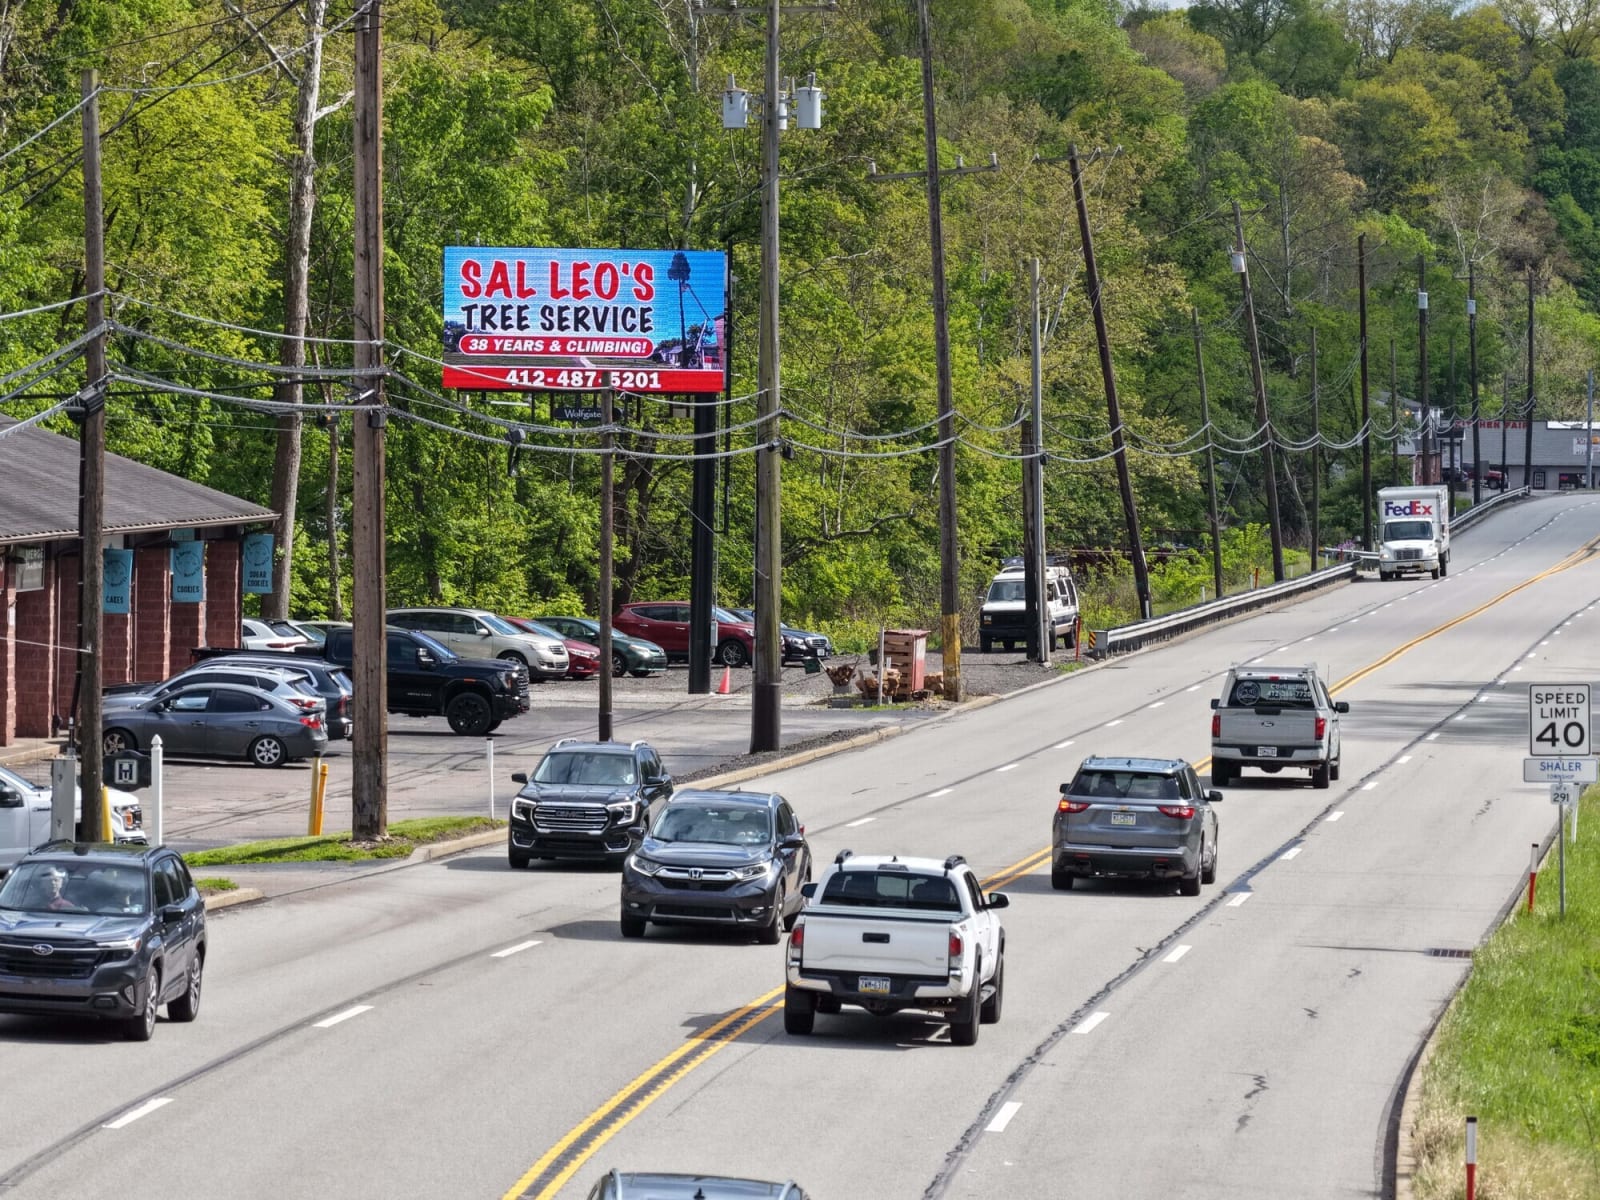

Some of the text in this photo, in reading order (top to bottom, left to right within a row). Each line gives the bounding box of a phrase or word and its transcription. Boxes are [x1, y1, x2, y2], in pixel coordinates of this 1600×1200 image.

[460, 259, 655, 301] SAL LEO'S
[461, 304, 654, 333] TREE SERVICE
[468, 338, 647, 354] 38 YEARS & CLIMBING!
[563, 408, 602, 420] Wolfgate
[1455, 420, 1501, 429] KITHEN
[1384, 500, 1433, 516] FedEx
[249, 570, 267, 578] SUGAR
[176, 585, 200, 593] COOKIES
[1535, 692, 1586, 704] SPEED
[1540, 707, 1580, 719] LIMIT
[1535, 721, 1585, 748] 40
[1539, 761, 1582, 771] SHALER
[1553, 792, 1570, 802] 291
